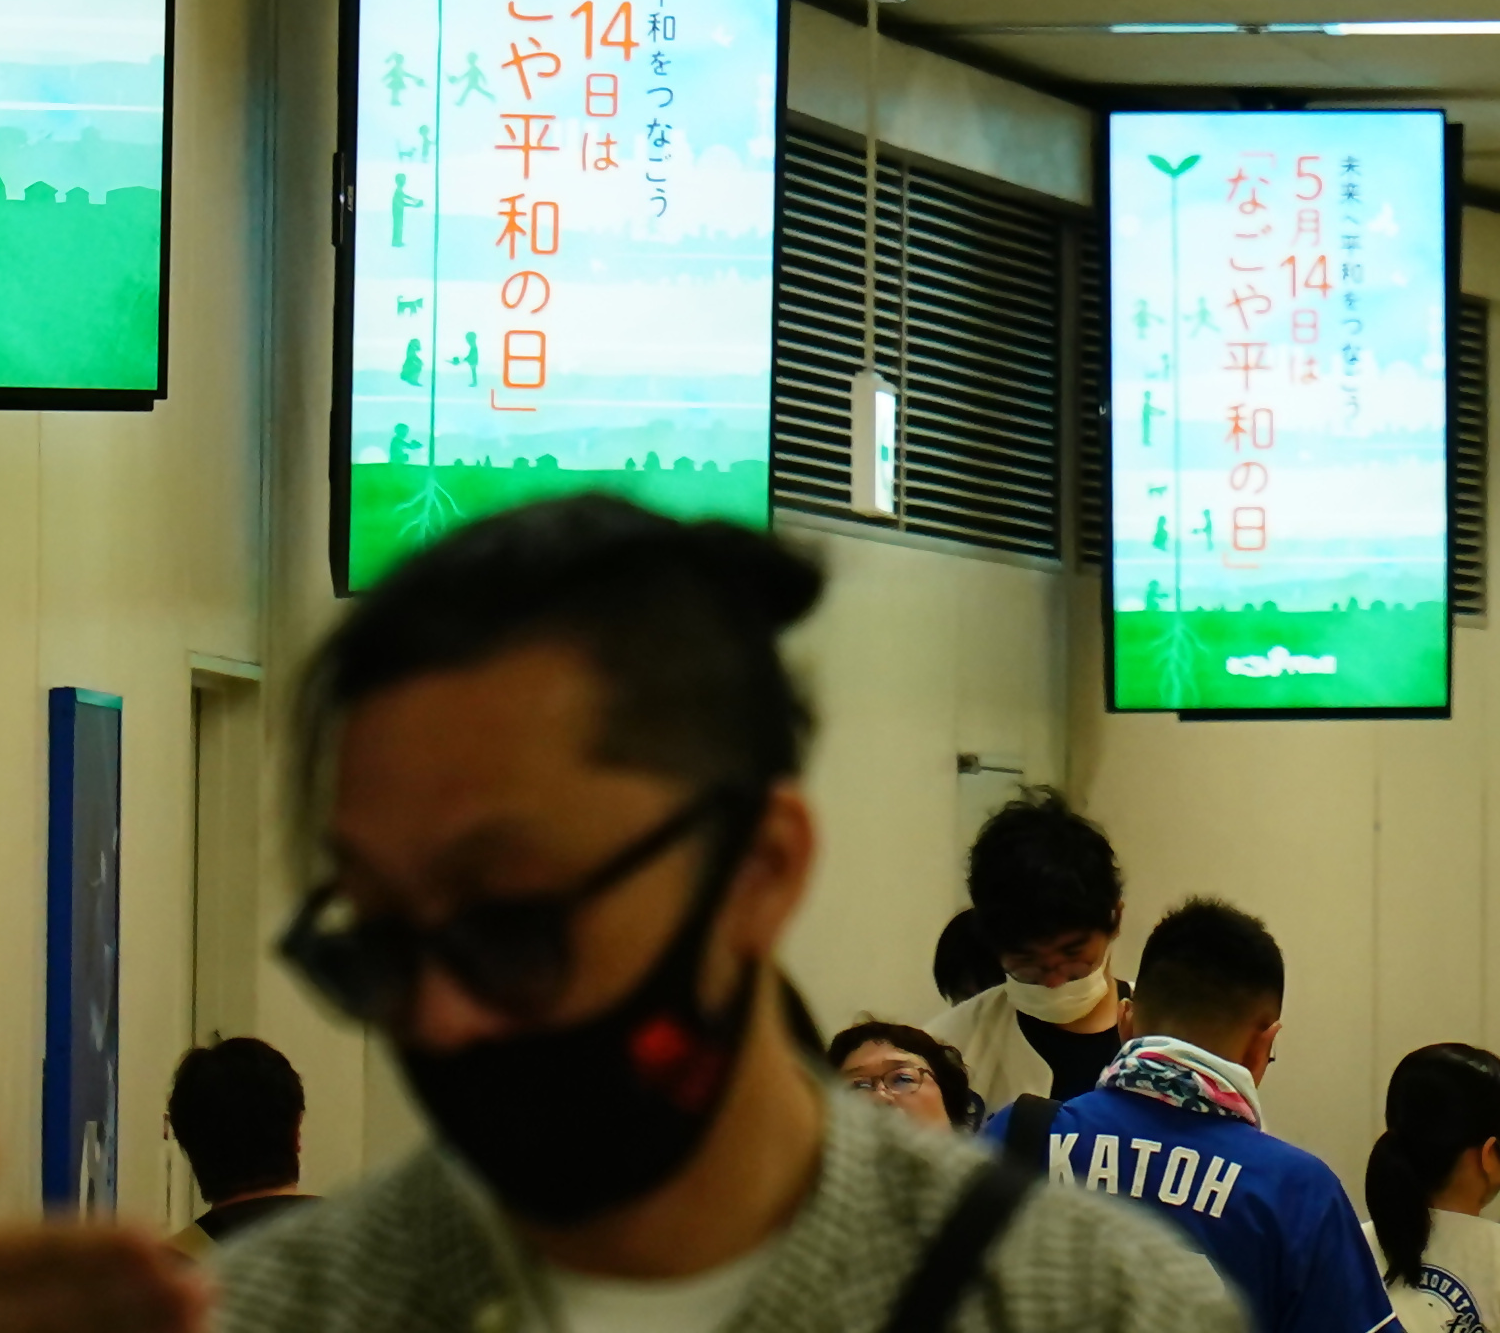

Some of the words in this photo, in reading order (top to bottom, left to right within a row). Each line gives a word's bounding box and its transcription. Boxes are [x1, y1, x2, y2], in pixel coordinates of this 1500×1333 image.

[1279, 155, 1334, 386] 5月14日は
[1049, 1132, 1242, 1219] KATOH
